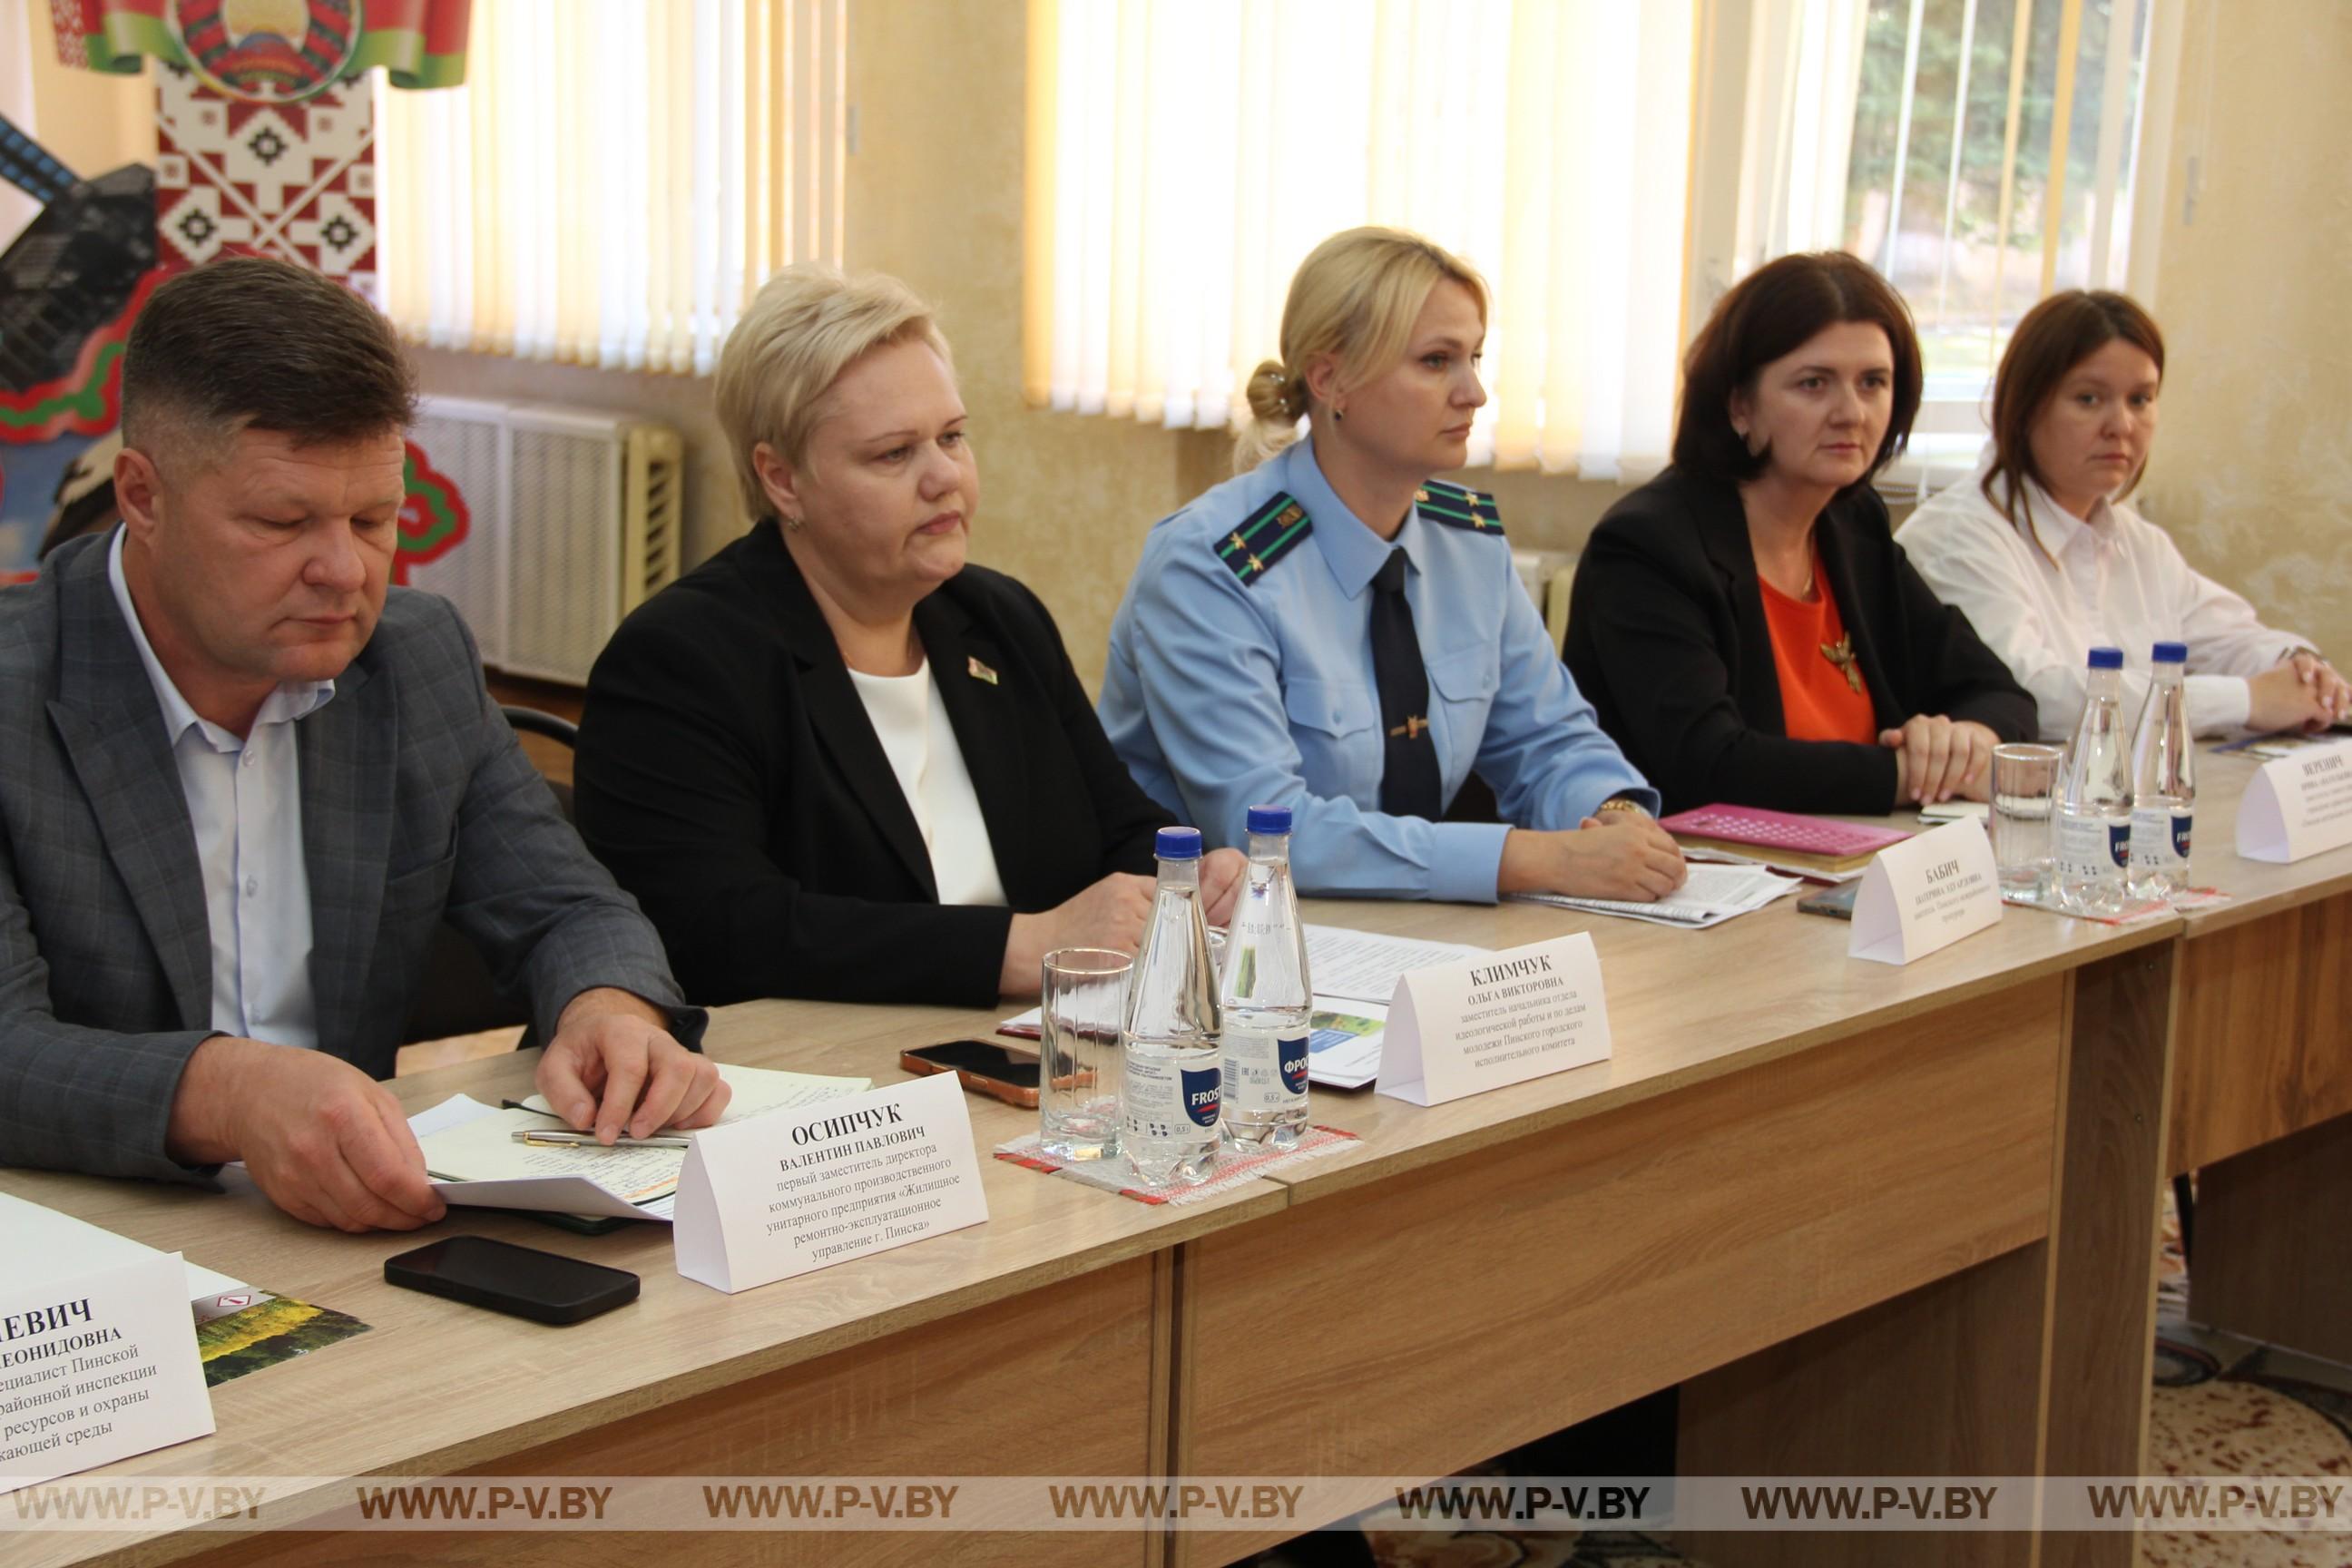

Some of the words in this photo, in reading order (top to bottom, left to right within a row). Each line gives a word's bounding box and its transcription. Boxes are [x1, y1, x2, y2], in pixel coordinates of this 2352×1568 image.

[1926, 859, 1959, 884] БАБИЧ
[1470, 955, 1552, 986] КЛИМЧУК
[1467, 991, 1500, 1005] ОЛЬГА
[1502, 976, 1563, 998] ВИКТОРОВНА
[1455, 1018, 1516, 1041] идеологической
[1518, 1013, 1545, 1030] работы
[1547, 1012, 1553, 1020] и
[1461, 1008, 1507, 1024] заместитель
[1508, 997, 1551, 1014] начальника
[1463, 1039, 1502, 1055] молодежи
[1504, 1030, 1541, 1046] Пинского
[1542, 1021, 1583, 1037] городского
[1475, 1047, 1540, 1068] исполнительного
[1542, 1037, 1575, 1052] комитета
[791, 1103, 903, 1146] ОСИПЧУК
[777, 1171, 818, 1191] первый
[819, 1158, 883, 1181] заместитель
[886, 1143, 936, 1166] директора
[779, 1143, 853, 1171] ВАЛЕНТИН
[855, 1126, 926, 1152] ПАВЛОВИЧ
[769, 1183, 852, 1212] коммунального
[854, 1159, 951, 1193] производственного
[767, 1209, 828, 1236] унитарного
[830, 1191, 896, 1218] предприятия
[898, 1174, 960, 1198] «Жилищное
[793, 1198, 942, 1248] ремонтно-эксплуатационное
[812, 1236, 872, 1262] управление
[875, 1232, 883, 1241] г.
[886, 1221, 930, 1240] Пинска»
[0, 1298, 94, 1343] ЕВИЧ
[0, 1327, 122, 1369] ЕОНИДОВНА
[72, 1344, 139, 1373] Пинской
[76, 1365, 157, 1396] инспекции
[5, 1408, 75, 1441] ресурсов
[80, 1405, 89, 1417] и
[93, 1389, 149, 1414] охраны
[66, 1422, 113, 1446] среды
